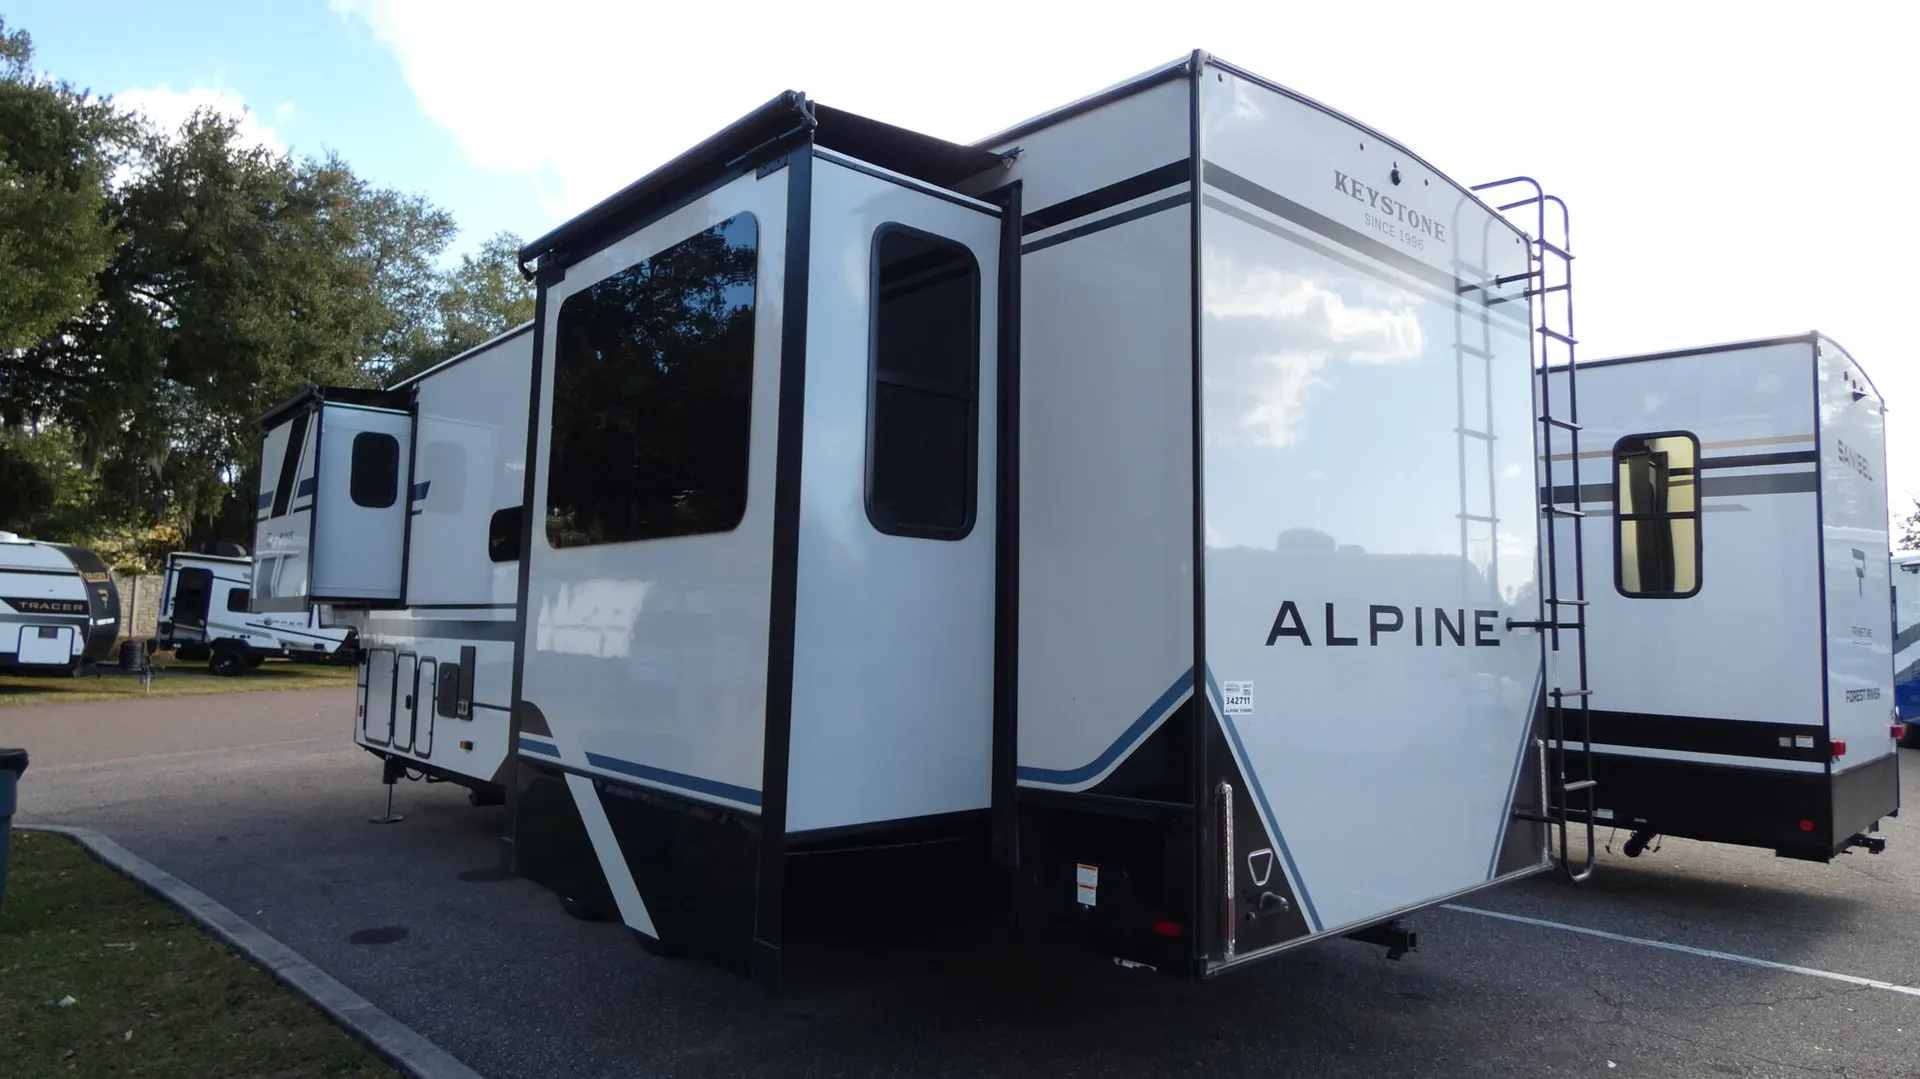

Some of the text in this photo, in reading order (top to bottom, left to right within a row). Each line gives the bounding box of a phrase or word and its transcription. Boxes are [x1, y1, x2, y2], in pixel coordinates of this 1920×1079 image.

[1333, 169, 1446, 243] KEYSTONE
[1364, 212, 1425, 252] SINCE 1996
[18, 600, 84, 611] TRACER
[1264, 600, 1501, 647] ALPINE
[1225, 696, 1251, 705] 342711
